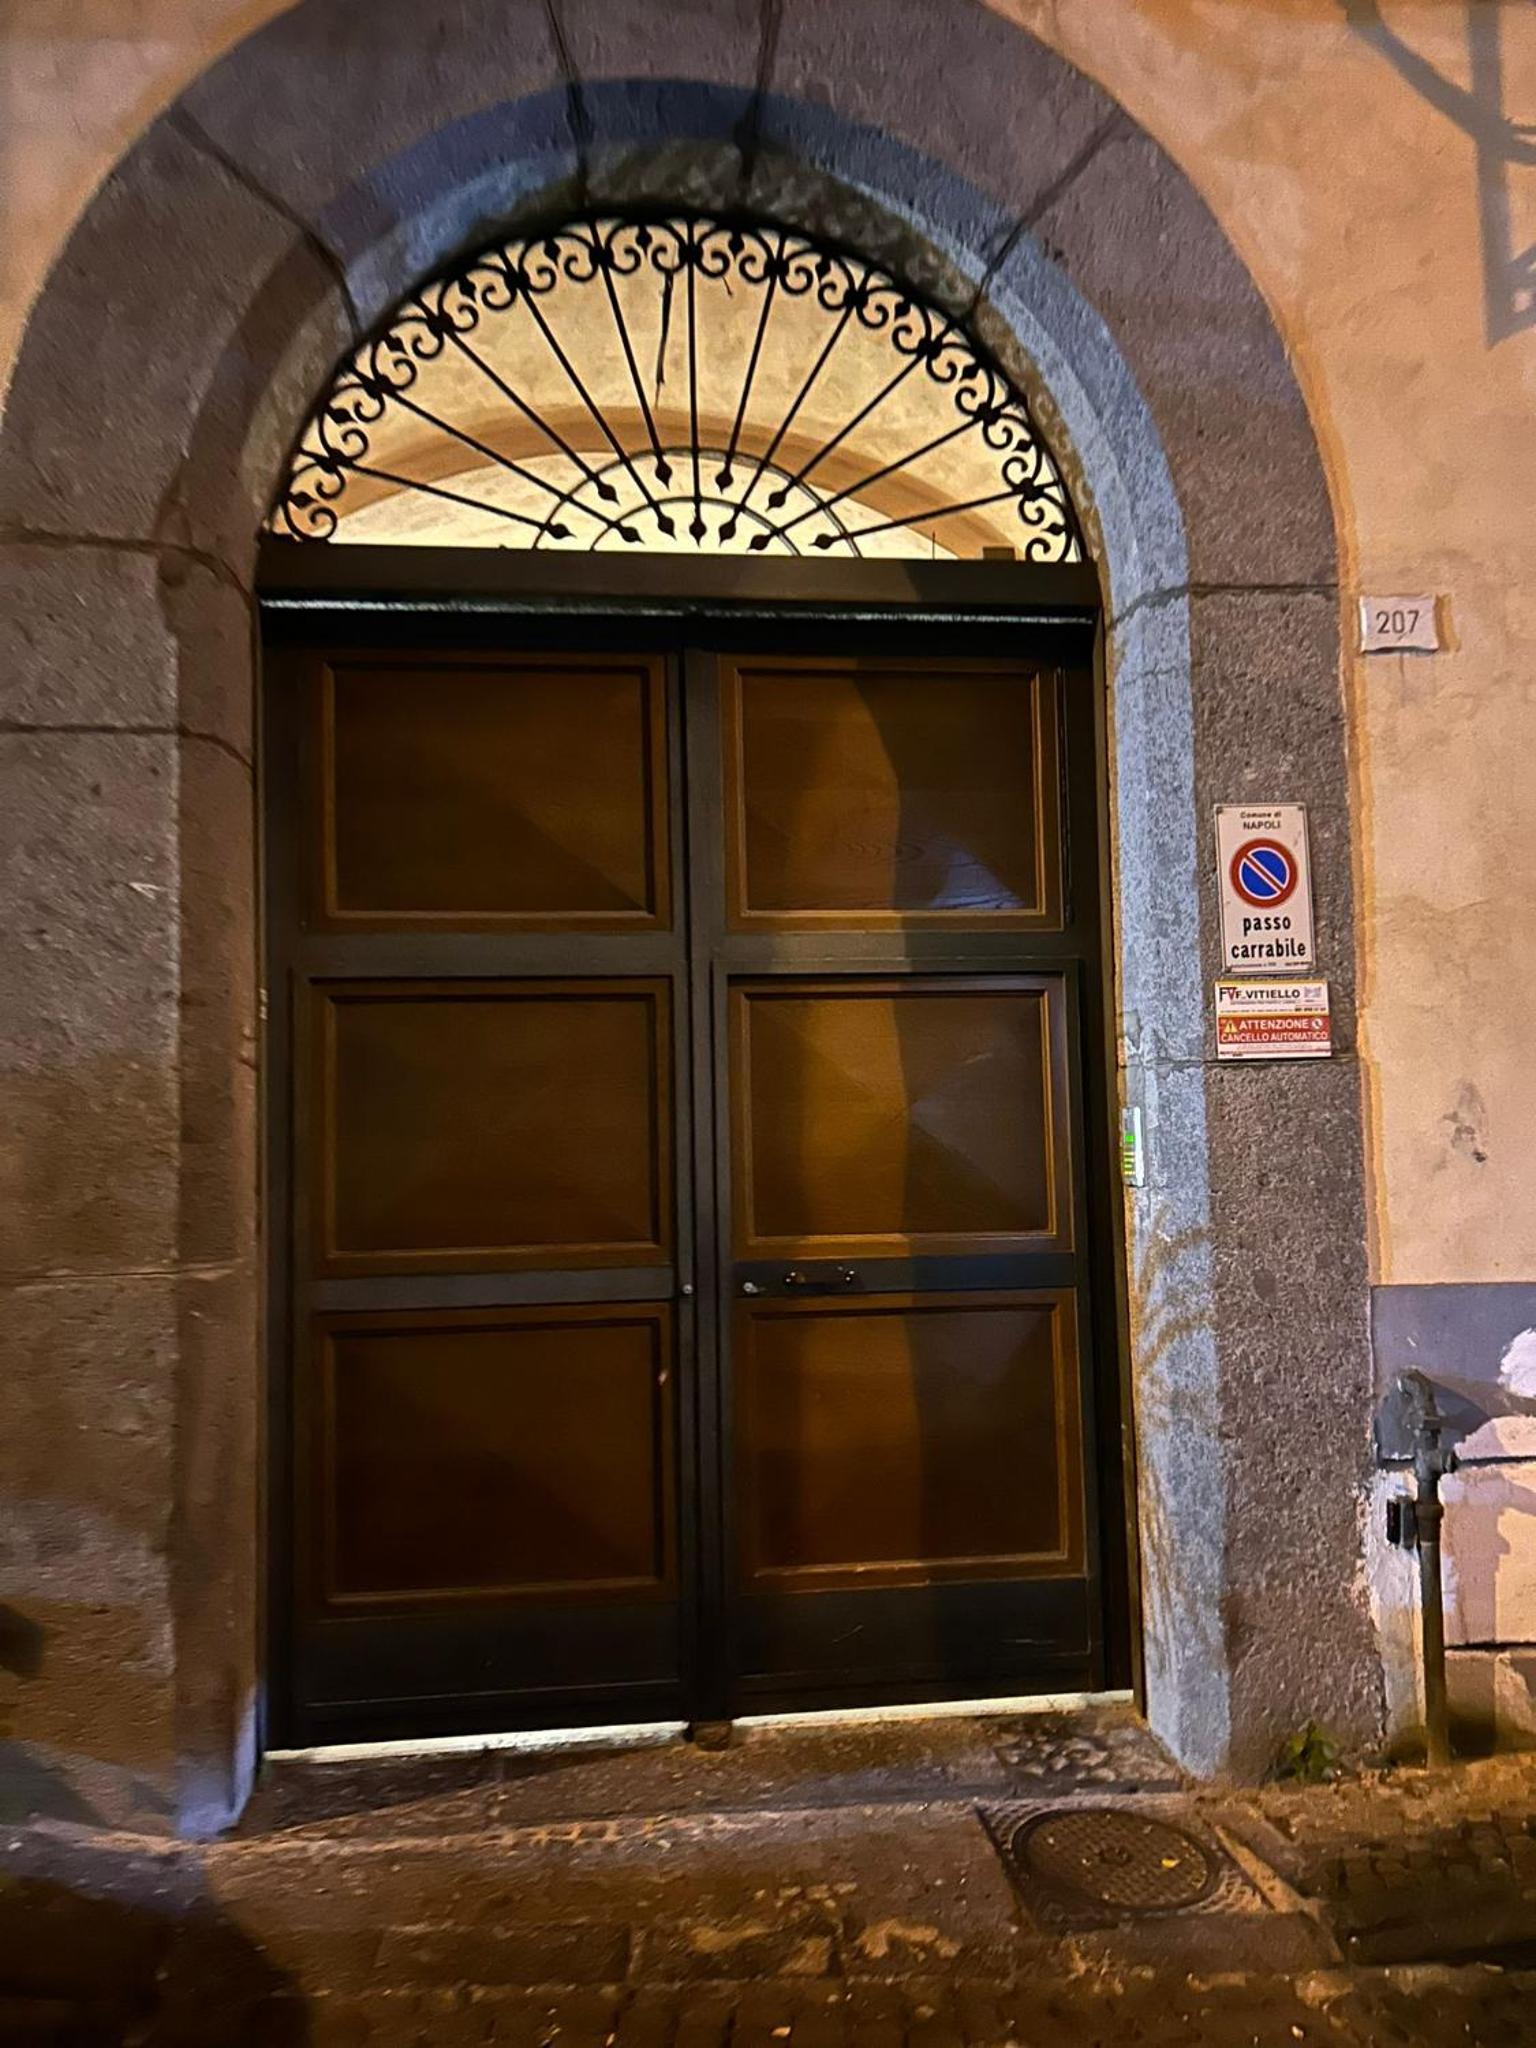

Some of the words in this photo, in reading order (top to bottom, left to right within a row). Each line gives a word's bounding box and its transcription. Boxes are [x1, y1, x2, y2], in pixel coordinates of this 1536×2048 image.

[1376, 609, 1419, 634] 207
[1240, 811, 1271, 819] Comune
[1243, 820, 1281, 830] NAPOLI
[1243, 916, 1291, 936] passo
[1231, 938, 1306, 959] carrabile
[1246, 989, 1301, 998] VITIELLO
[1239, 1019, 1309, 1030] ATTENZIONE
[1221, 1032, 1269, 1042] CANCELLO
[1271, 1031, 1328, 1041] AUTOMATICO
